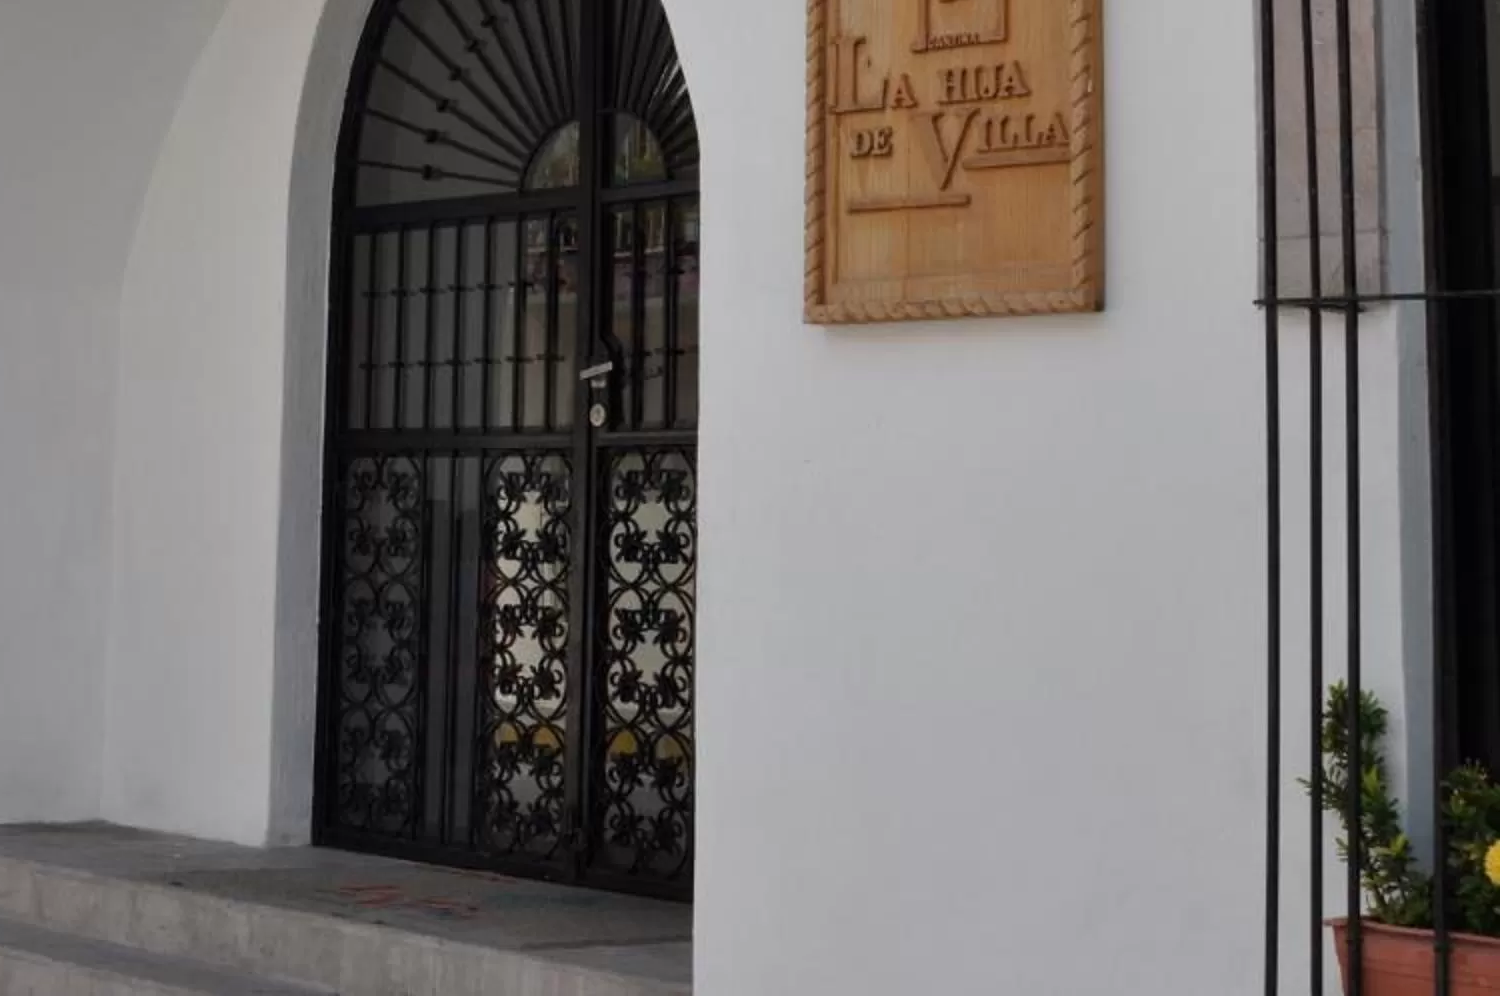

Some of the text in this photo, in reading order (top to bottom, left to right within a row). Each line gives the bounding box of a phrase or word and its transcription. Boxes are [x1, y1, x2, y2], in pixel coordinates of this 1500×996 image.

[828, 36, 1032, 114] LA HIJA
[850, 107, 1071, 192] DE VILLA
